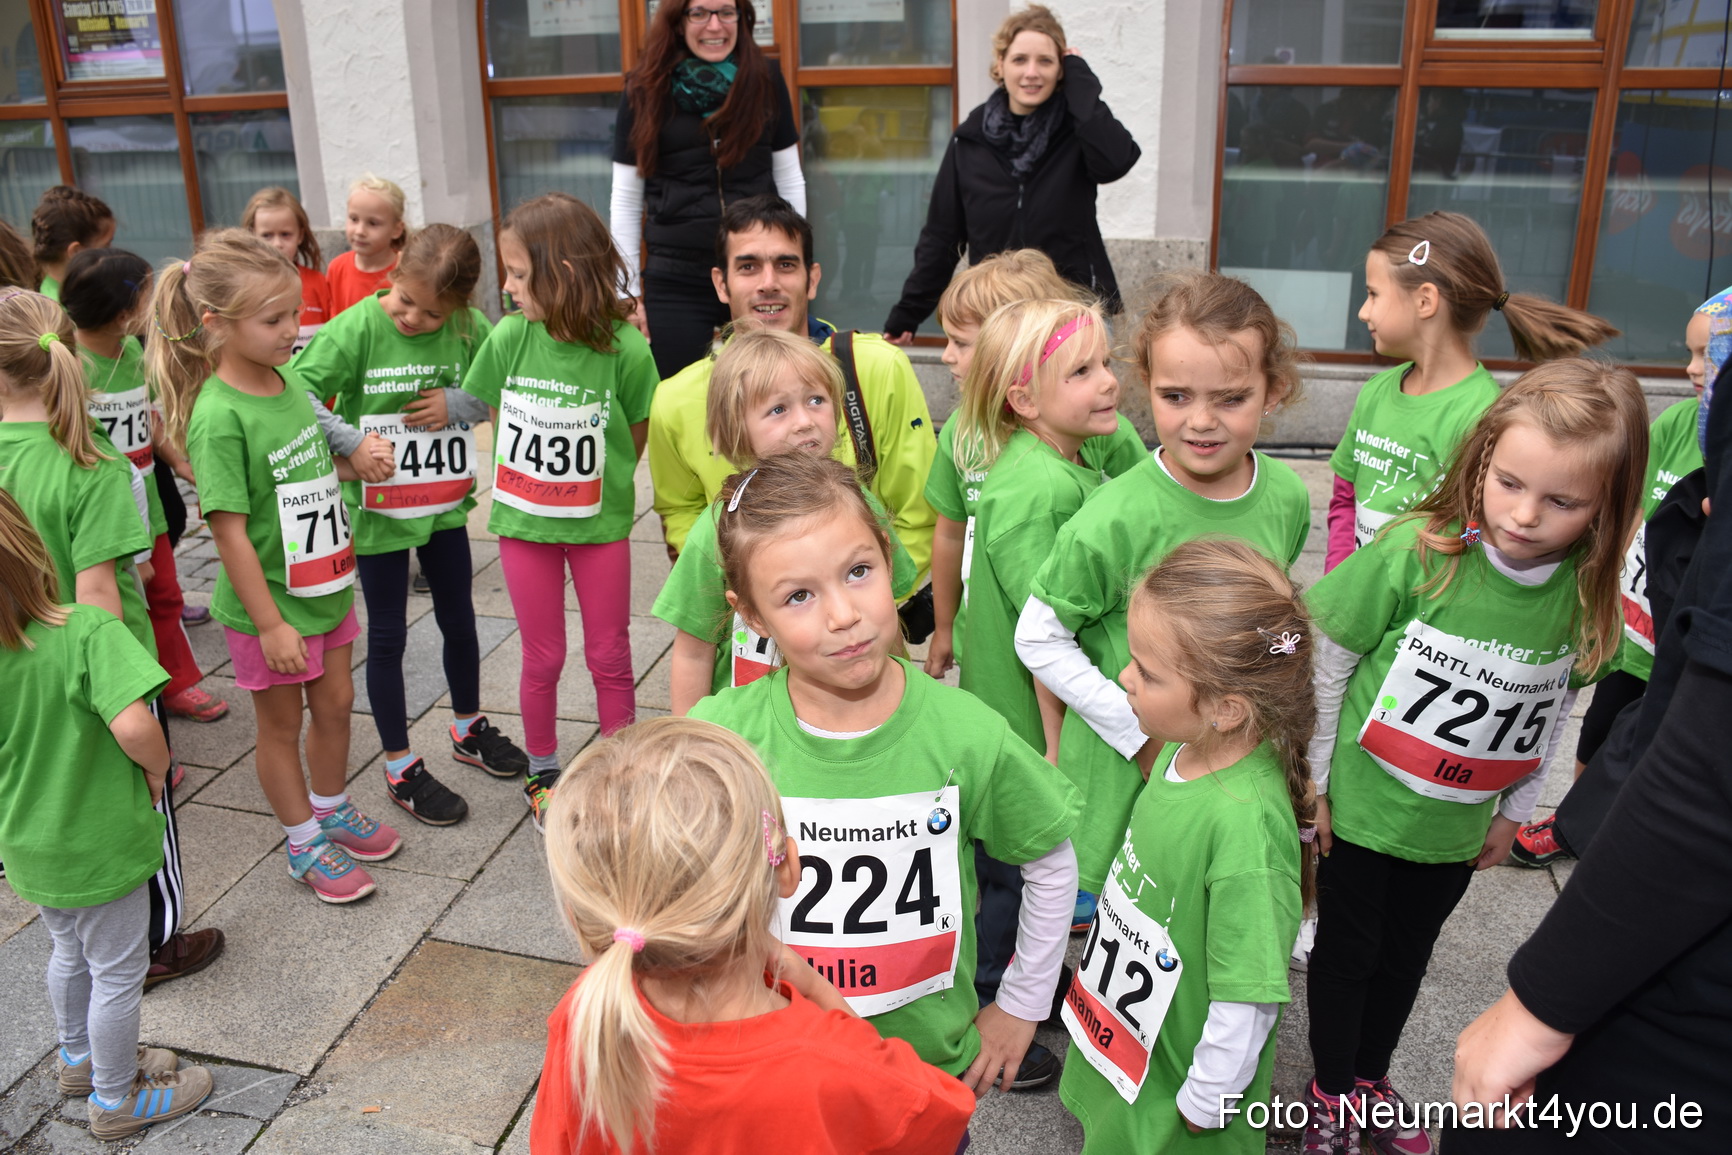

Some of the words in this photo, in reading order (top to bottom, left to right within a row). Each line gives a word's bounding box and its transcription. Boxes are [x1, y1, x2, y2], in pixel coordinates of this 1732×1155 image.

[365, 363, 436, 379] eumarkter
[363, 379, 421, 394] tadtlauf
[88, 403, 124, 412] PARTL
[503, 402, 528, 423] PARTL
[531, 415, 587, 430] Neumarkt
[392, 437, 466, 477] 440
[508, 422, 596, 476] 7430
[501, 471, 579, 497] CHRISTINA
[282, 492, 324, 508] PARTL
[1408, 637, 1471, 677] PARTL
[1476, 668, 1555, 694] Neumarkt
[1401, 668, 1555, 754] 7215
[1434, 758, 1473, 784] Ida
[800, 819, 918, 842] Neumarkt
[790, 847, 941, 934] 224
[1100, 889, 1150, 955] Neumarkt
